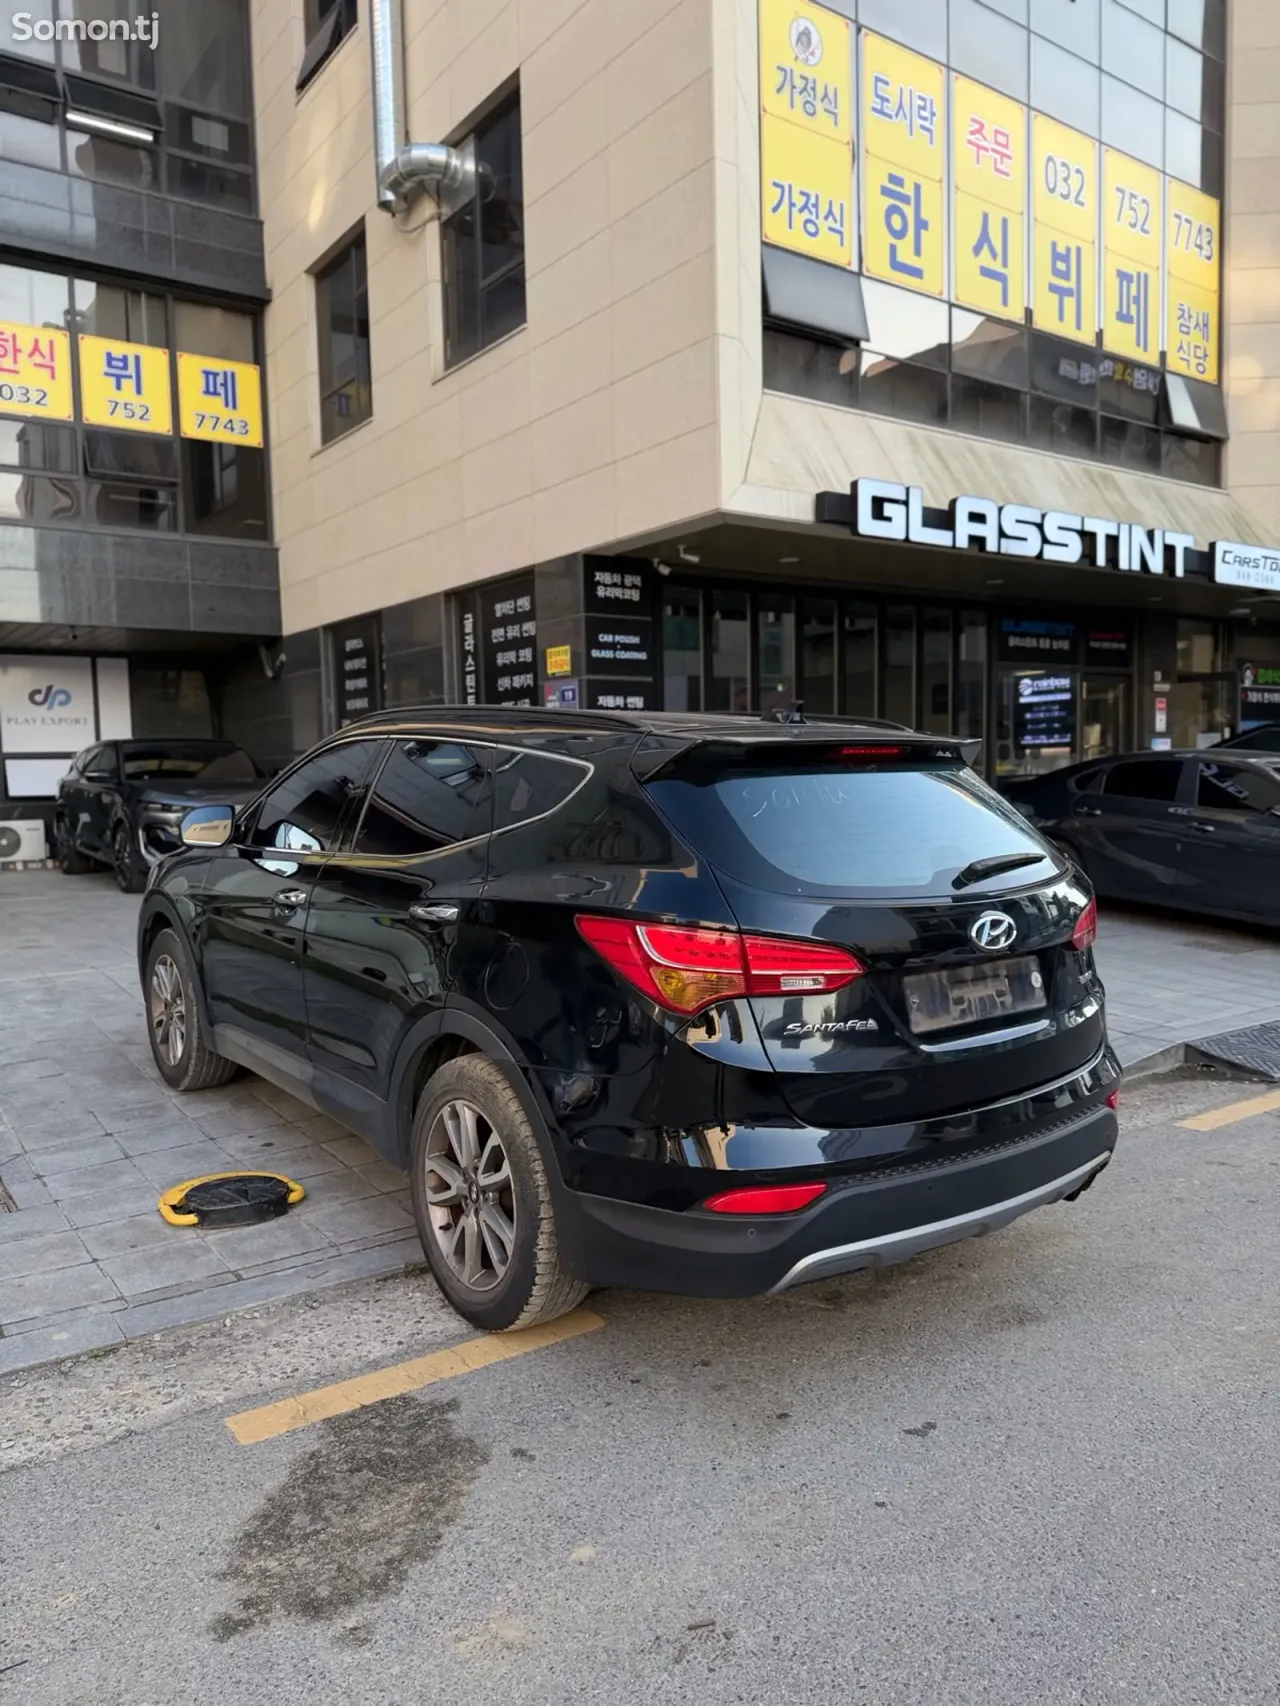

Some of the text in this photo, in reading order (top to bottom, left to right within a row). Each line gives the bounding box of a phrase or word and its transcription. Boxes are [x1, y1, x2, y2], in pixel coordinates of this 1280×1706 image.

[775, 62, 1214, 262] 가정식 도시락 주문 032 752 7743
[771, 172, 1150, 353] 가정식 한 식 뷔 페
[1176, 302, 1210, 343] 참새
[104, 351, 143, 396] 뷔
[201, 369, 237, 411] 페
[1176, 340, 1208, 376] 식당
[0, 384, 249, 436] 032 752 7743
[857, 478, 1194, 578] GLASSTINT
[591, 649, 647, 660] GLASS COATING
[598, 633, 613, 642] CAR
[7, 716, 88, 726] PLAY EXPORT
